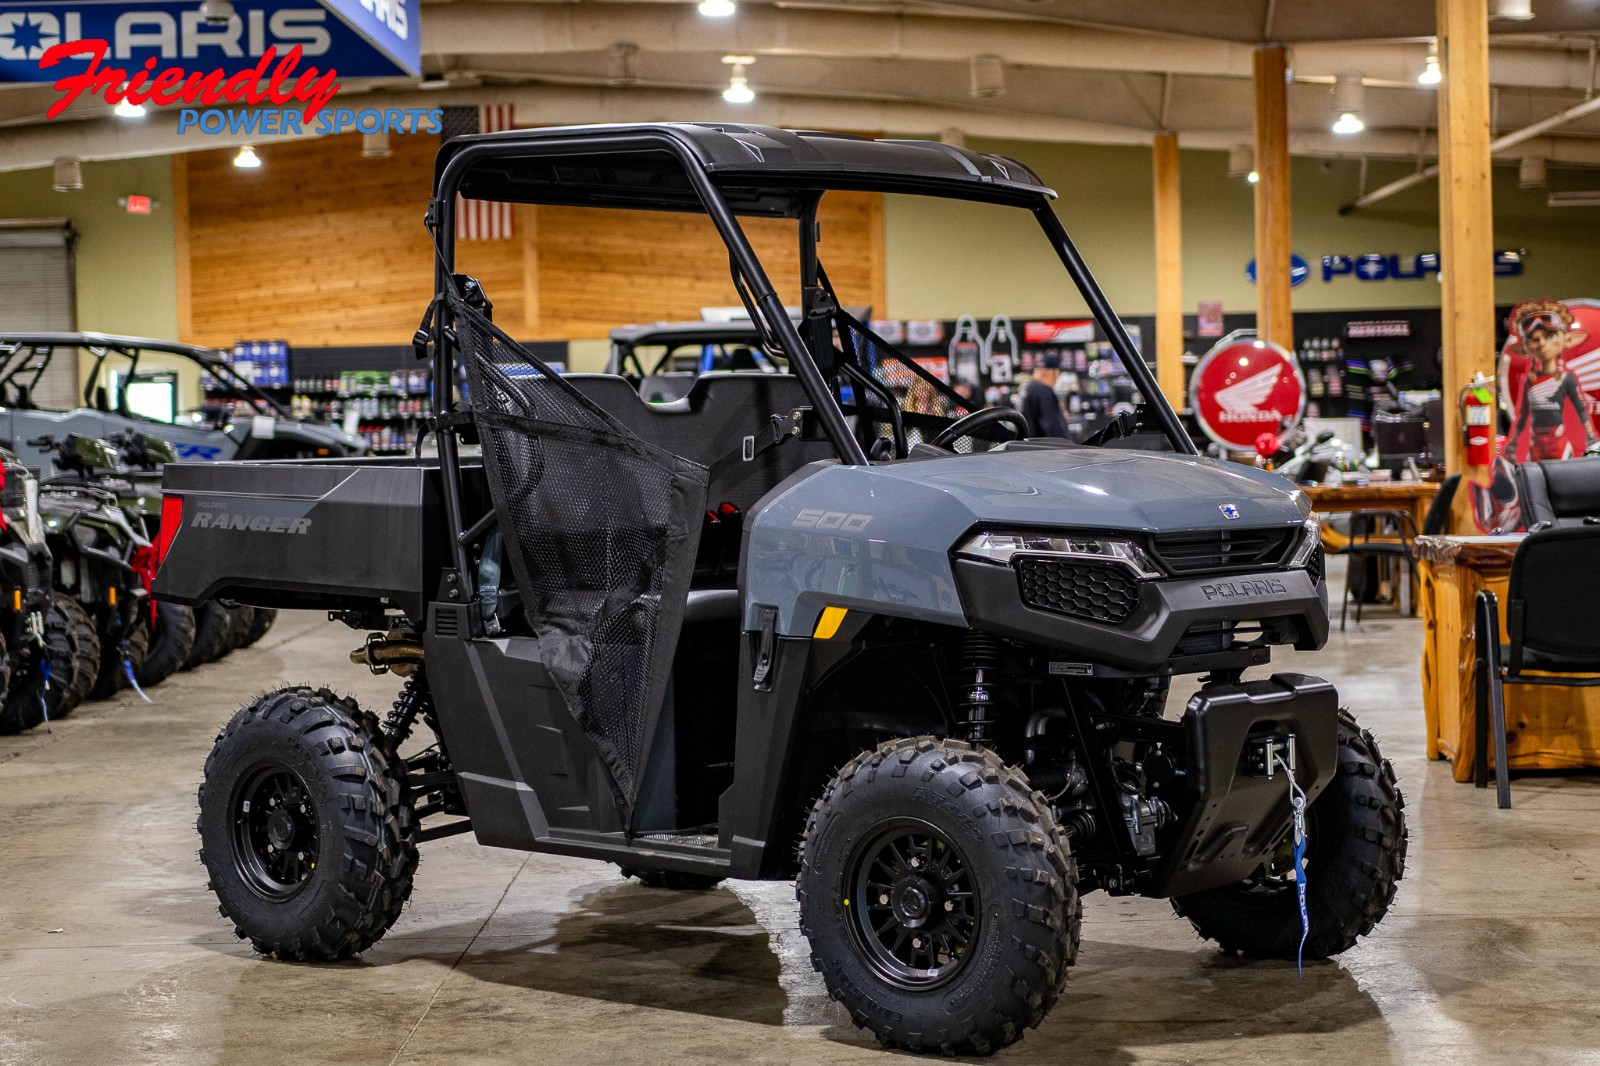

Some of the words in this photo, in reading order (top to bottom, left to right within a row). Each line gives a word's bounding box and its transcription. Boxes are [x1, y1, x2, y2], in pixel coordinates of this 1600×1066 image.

[1219, 407, 1281, 423] HONDA
[197, 501, 228, 509] POLARIS
[190, 511, 312, 535] RANGER
[791, 508, 874, 533] 500
[1200, 579, 1287, 601] POLARIS
